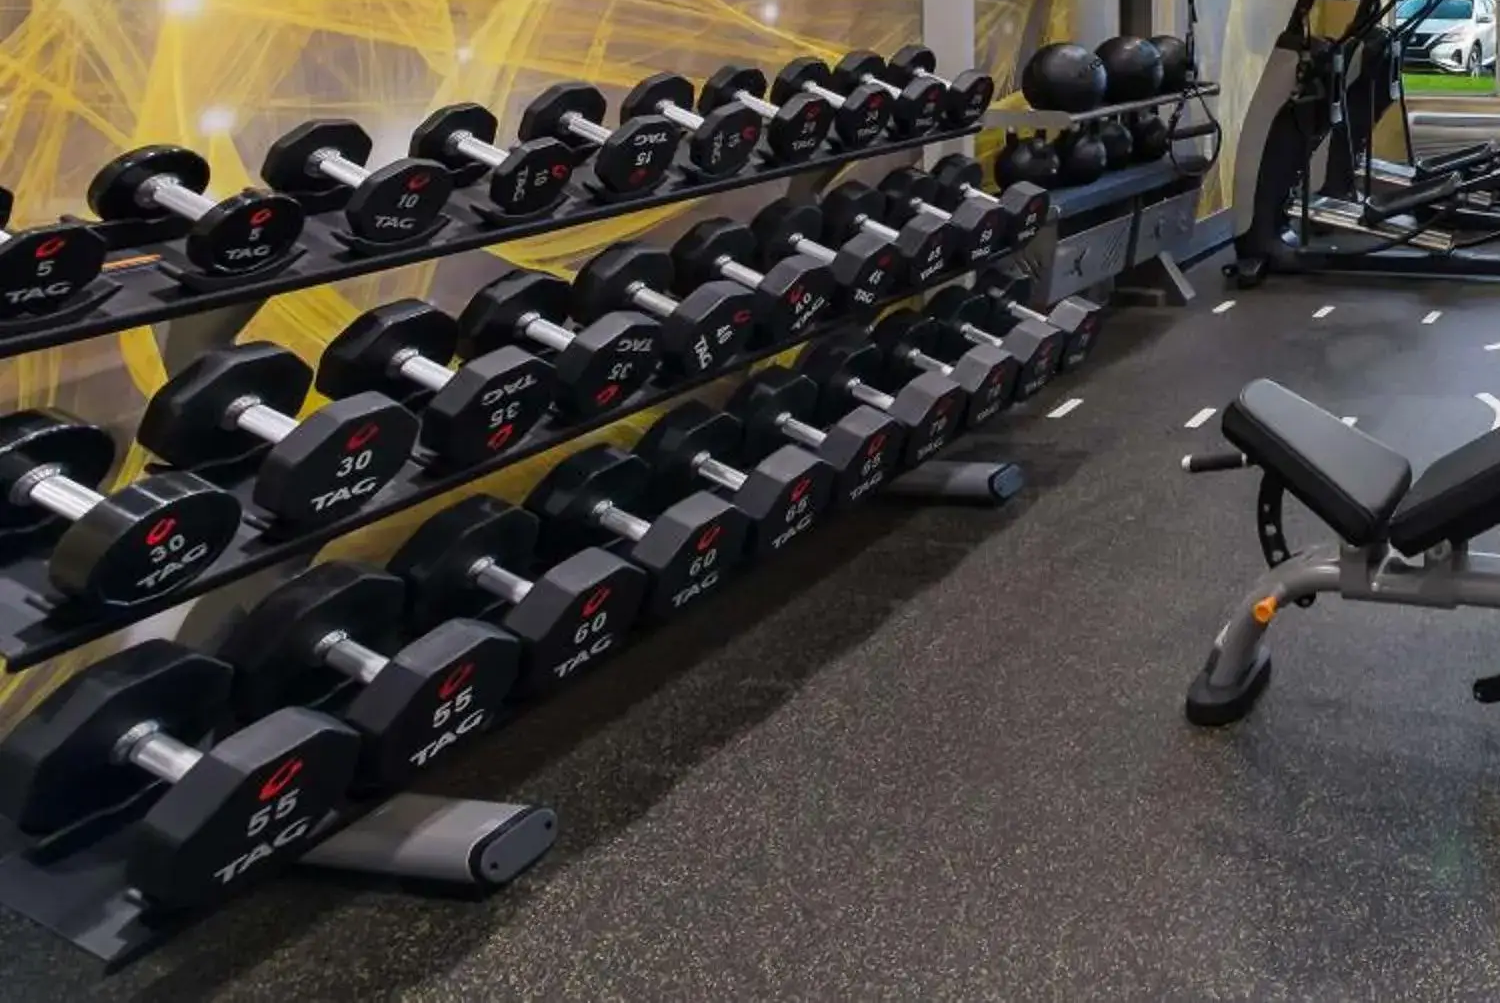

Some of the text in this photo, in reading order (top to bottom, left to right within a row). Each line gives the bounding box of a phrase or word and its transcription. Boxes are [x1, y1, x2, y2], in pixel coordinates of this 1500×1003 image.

[633, 132, 667, 146] TAG
[513, 166, 529, 202] TAG
[397, 194, 420, 209] 10
[249, 228, 258, 242] 5
[374, 214, 416, 230] TAG
[36, 261, 55, 277] 5
[224, 245, 269, 261] TAG
[4, 281, 72, 304] TAG
[616, 338, 654, 353] TAG
[693, 334, 713, 370] TAG
[481, 373, 540, 406] TAG
[335, 449, 373, 478] 30
[310, 476, 377, 513] TAG
[771, 513, 812, 549] TAG
[150, 533, 186, 563] 30
[689, 548, 717, 577] 60
[136, 543, 208, 589] TAG
[672, 571, 719, 608] TAG
[574, 612, 607, 645] 60
[553, 633, 613, 678] TAG
[433, 686, 474, 729] 55
[408, 708, 485, 767] TAG
[247, 788, 300, 838] 55
[213, 815, 311, 885] TAG
